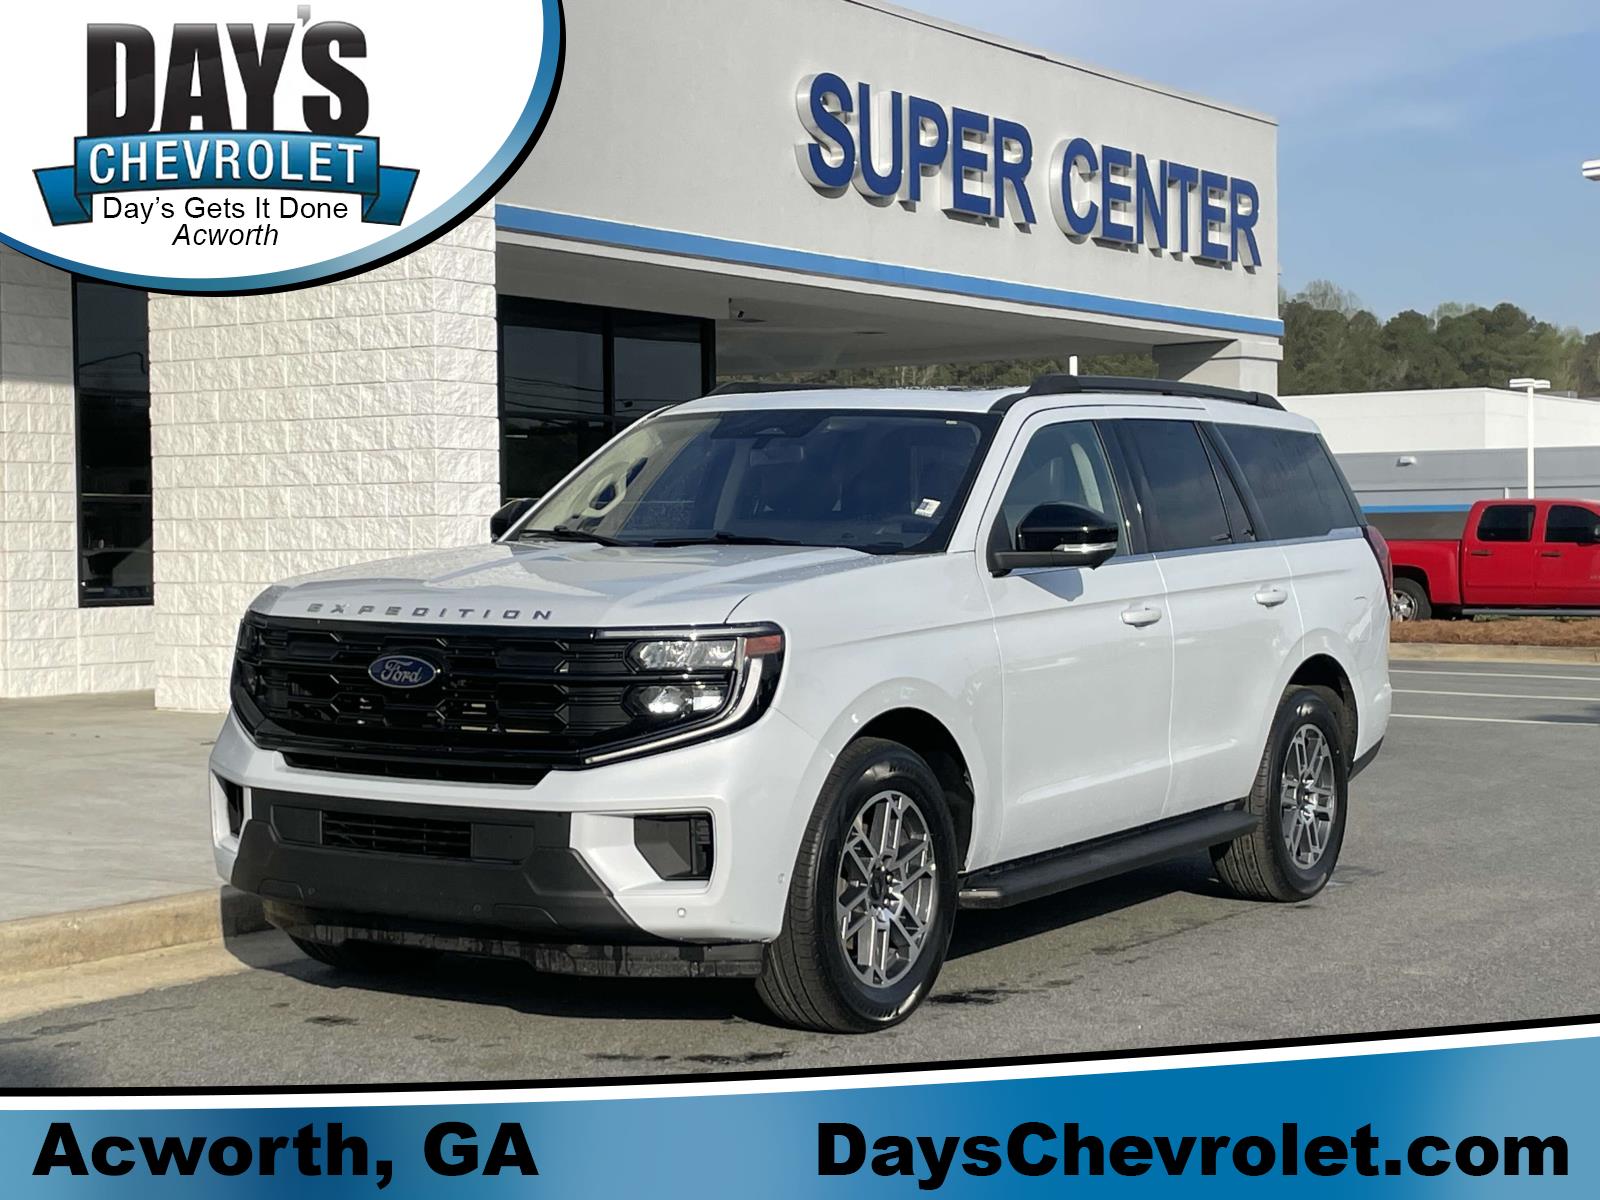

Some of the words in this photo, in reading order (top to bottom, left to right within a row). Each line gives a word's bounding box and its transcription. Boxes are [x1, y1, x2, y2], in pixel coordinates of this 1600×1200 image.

[800, 72, 1038, 226] SUPER
[1055, 137, 1263, 268] CENTER
[307, 602, 553, 622] EXPEDITION
[380, 658, 423, 684] Ford
